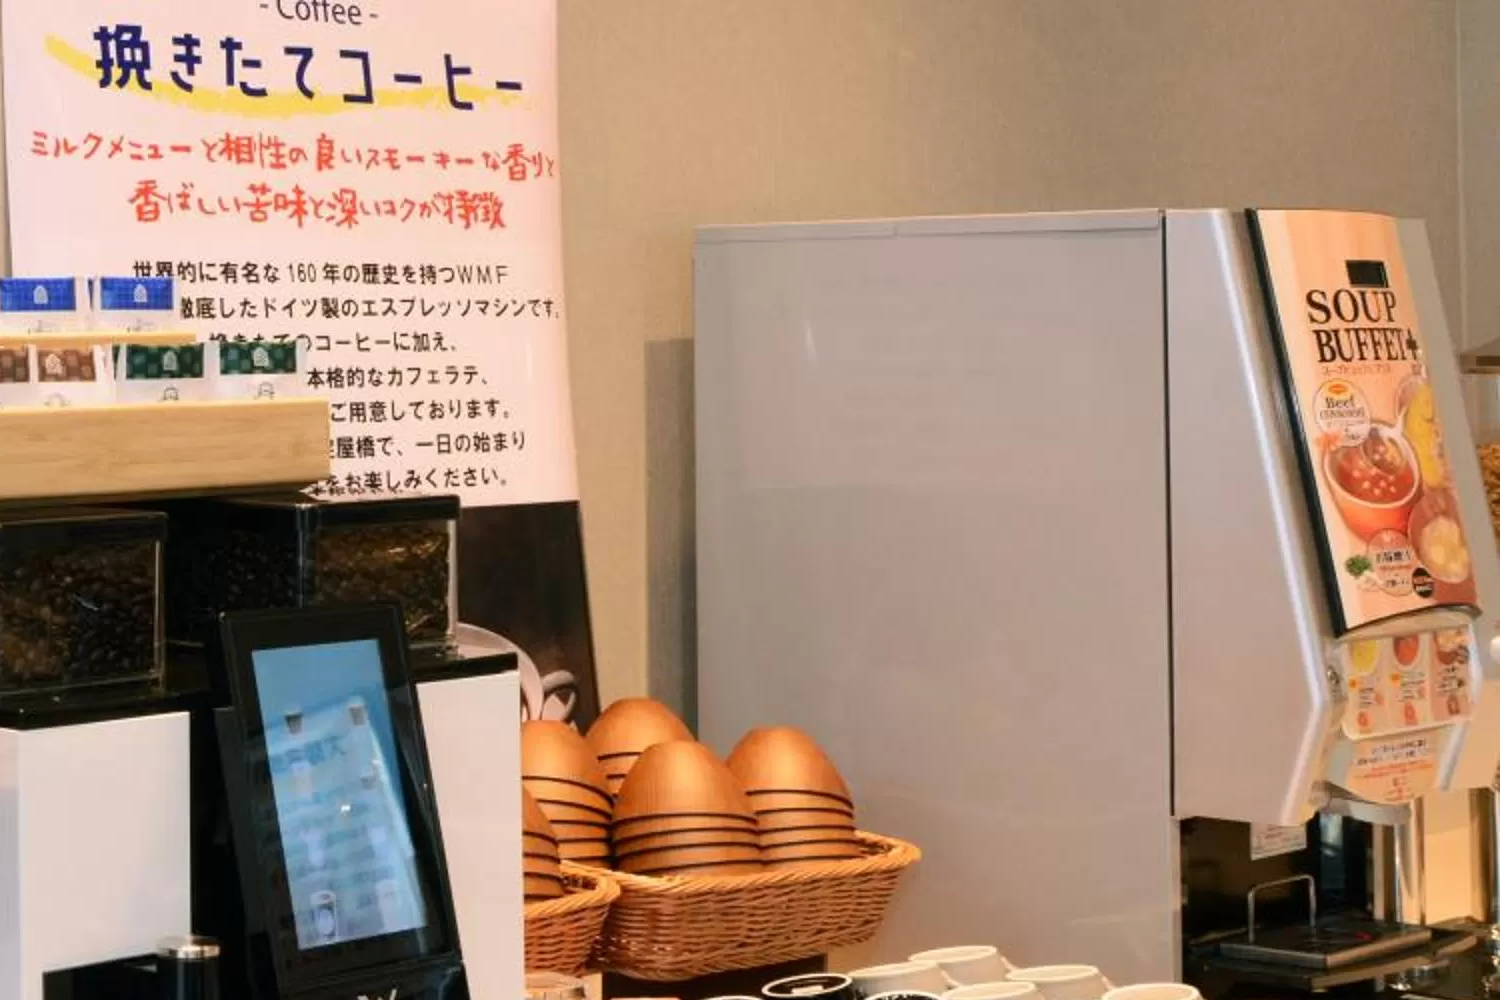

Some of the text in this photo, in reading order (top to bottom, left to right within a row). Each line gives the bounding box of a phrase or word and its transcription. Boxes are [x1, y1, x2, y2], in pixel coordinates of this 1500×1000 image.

[93, 23, 523, 111] 挽きたてコーヒー
[128, 179, 506, 230] 香ばしい苦味と深いコクが特徴
[1305, 289, 1398, 325] SOUP
[307, 364, 489, 389] 本格的なカフェラテ、
[330, 398, 510, 424] ご用意しております。
